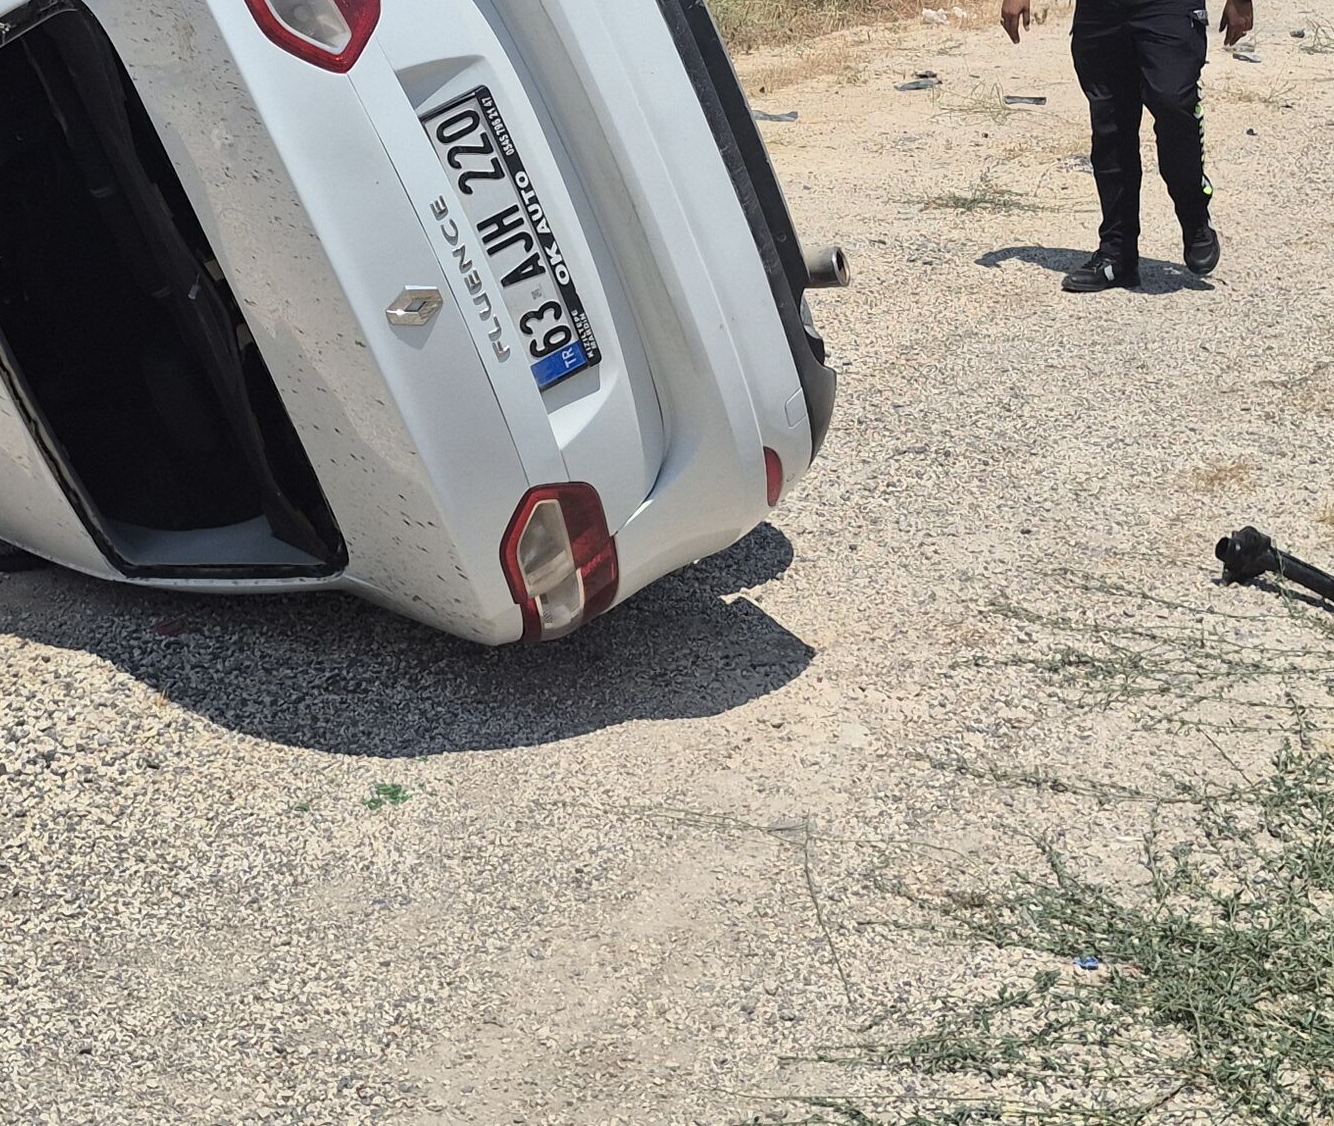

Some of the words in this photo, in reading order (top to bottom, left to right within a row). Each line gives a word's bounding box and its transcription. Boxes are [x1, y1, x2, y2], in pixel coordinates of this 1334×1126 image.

[481, 96, 493, 107] 47
[436, 109, 505, 195] 220
[515, 171, 551, 234] AUTO
[476, 204, 547, 288] AJH
[544, 241, 570, 285] OK
[429, 194, 512, 363] FLUENCE
[519, 300, 572, 358] 63
[561, 347, 577, 368] TR
